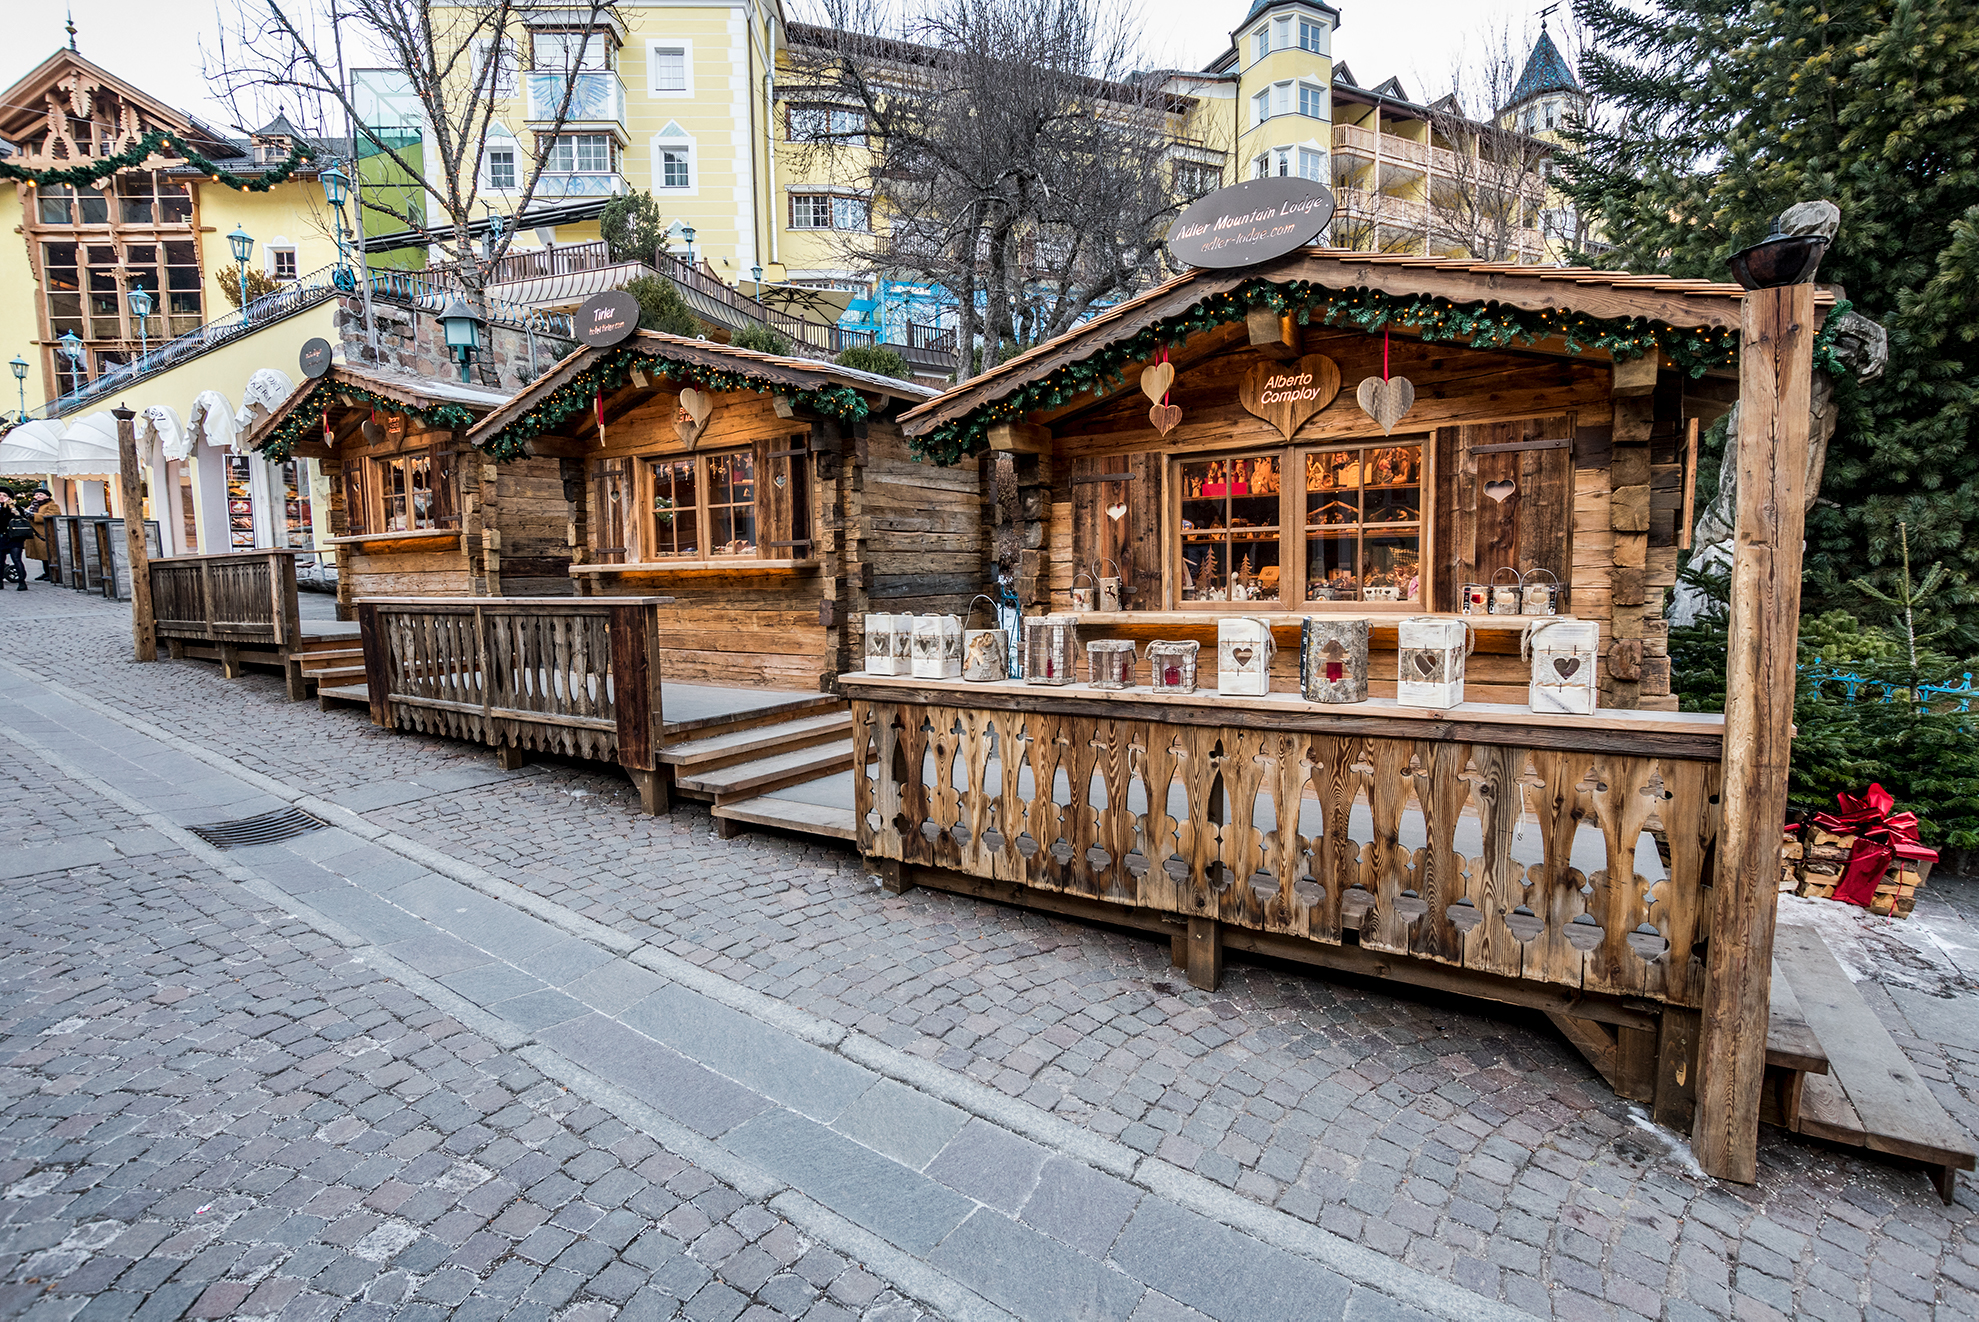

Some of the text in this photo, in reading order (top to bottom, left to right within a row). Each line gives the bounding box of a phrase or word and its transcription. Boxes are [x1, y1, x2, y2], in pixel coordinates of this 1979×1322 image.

[1176, 194, 1323, 241] Adler Mountain Lodge
[1200, 223, 1296, 252] adler-lodge.com
[593, 306, 616, 322] Tirler
[1263, 372, 1313, 390] Alberto
[1260, 386, 1321, 404] Comploy
